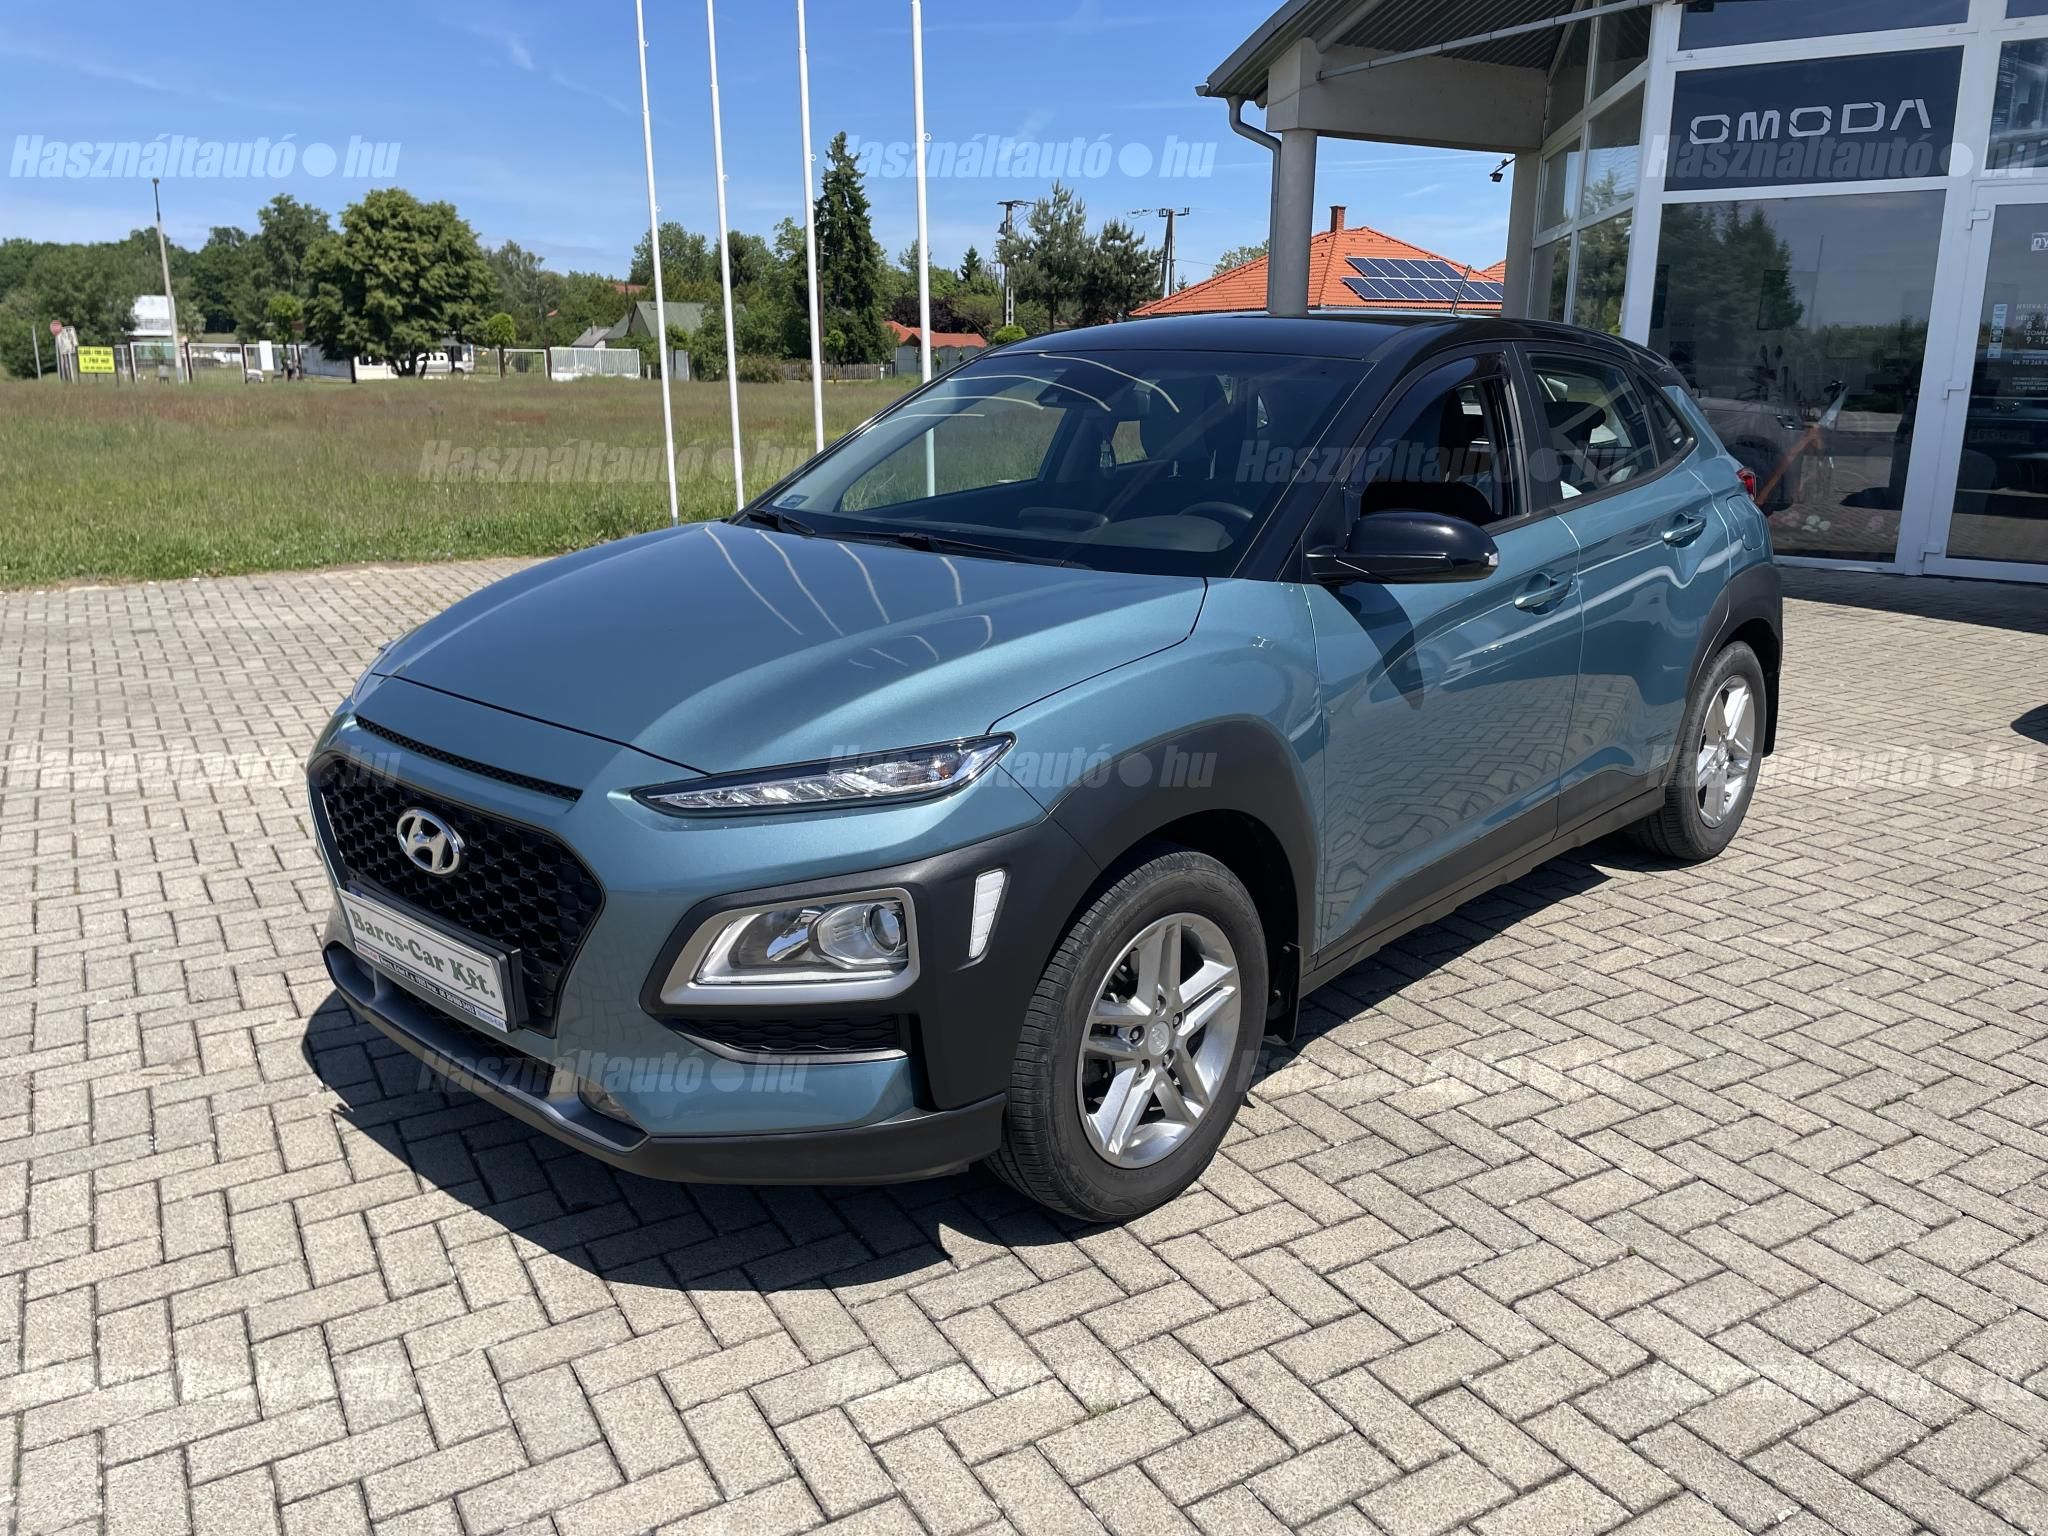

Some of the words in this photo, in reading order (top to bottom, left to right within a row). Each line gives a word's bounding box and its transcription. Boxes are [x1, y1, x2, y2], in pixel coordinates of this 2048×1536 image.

[1689, 98, 1932, 145] OMODA
[349, 908, 444, 973] Barcs-Car
[448, 957, 496, 999] Kft.
